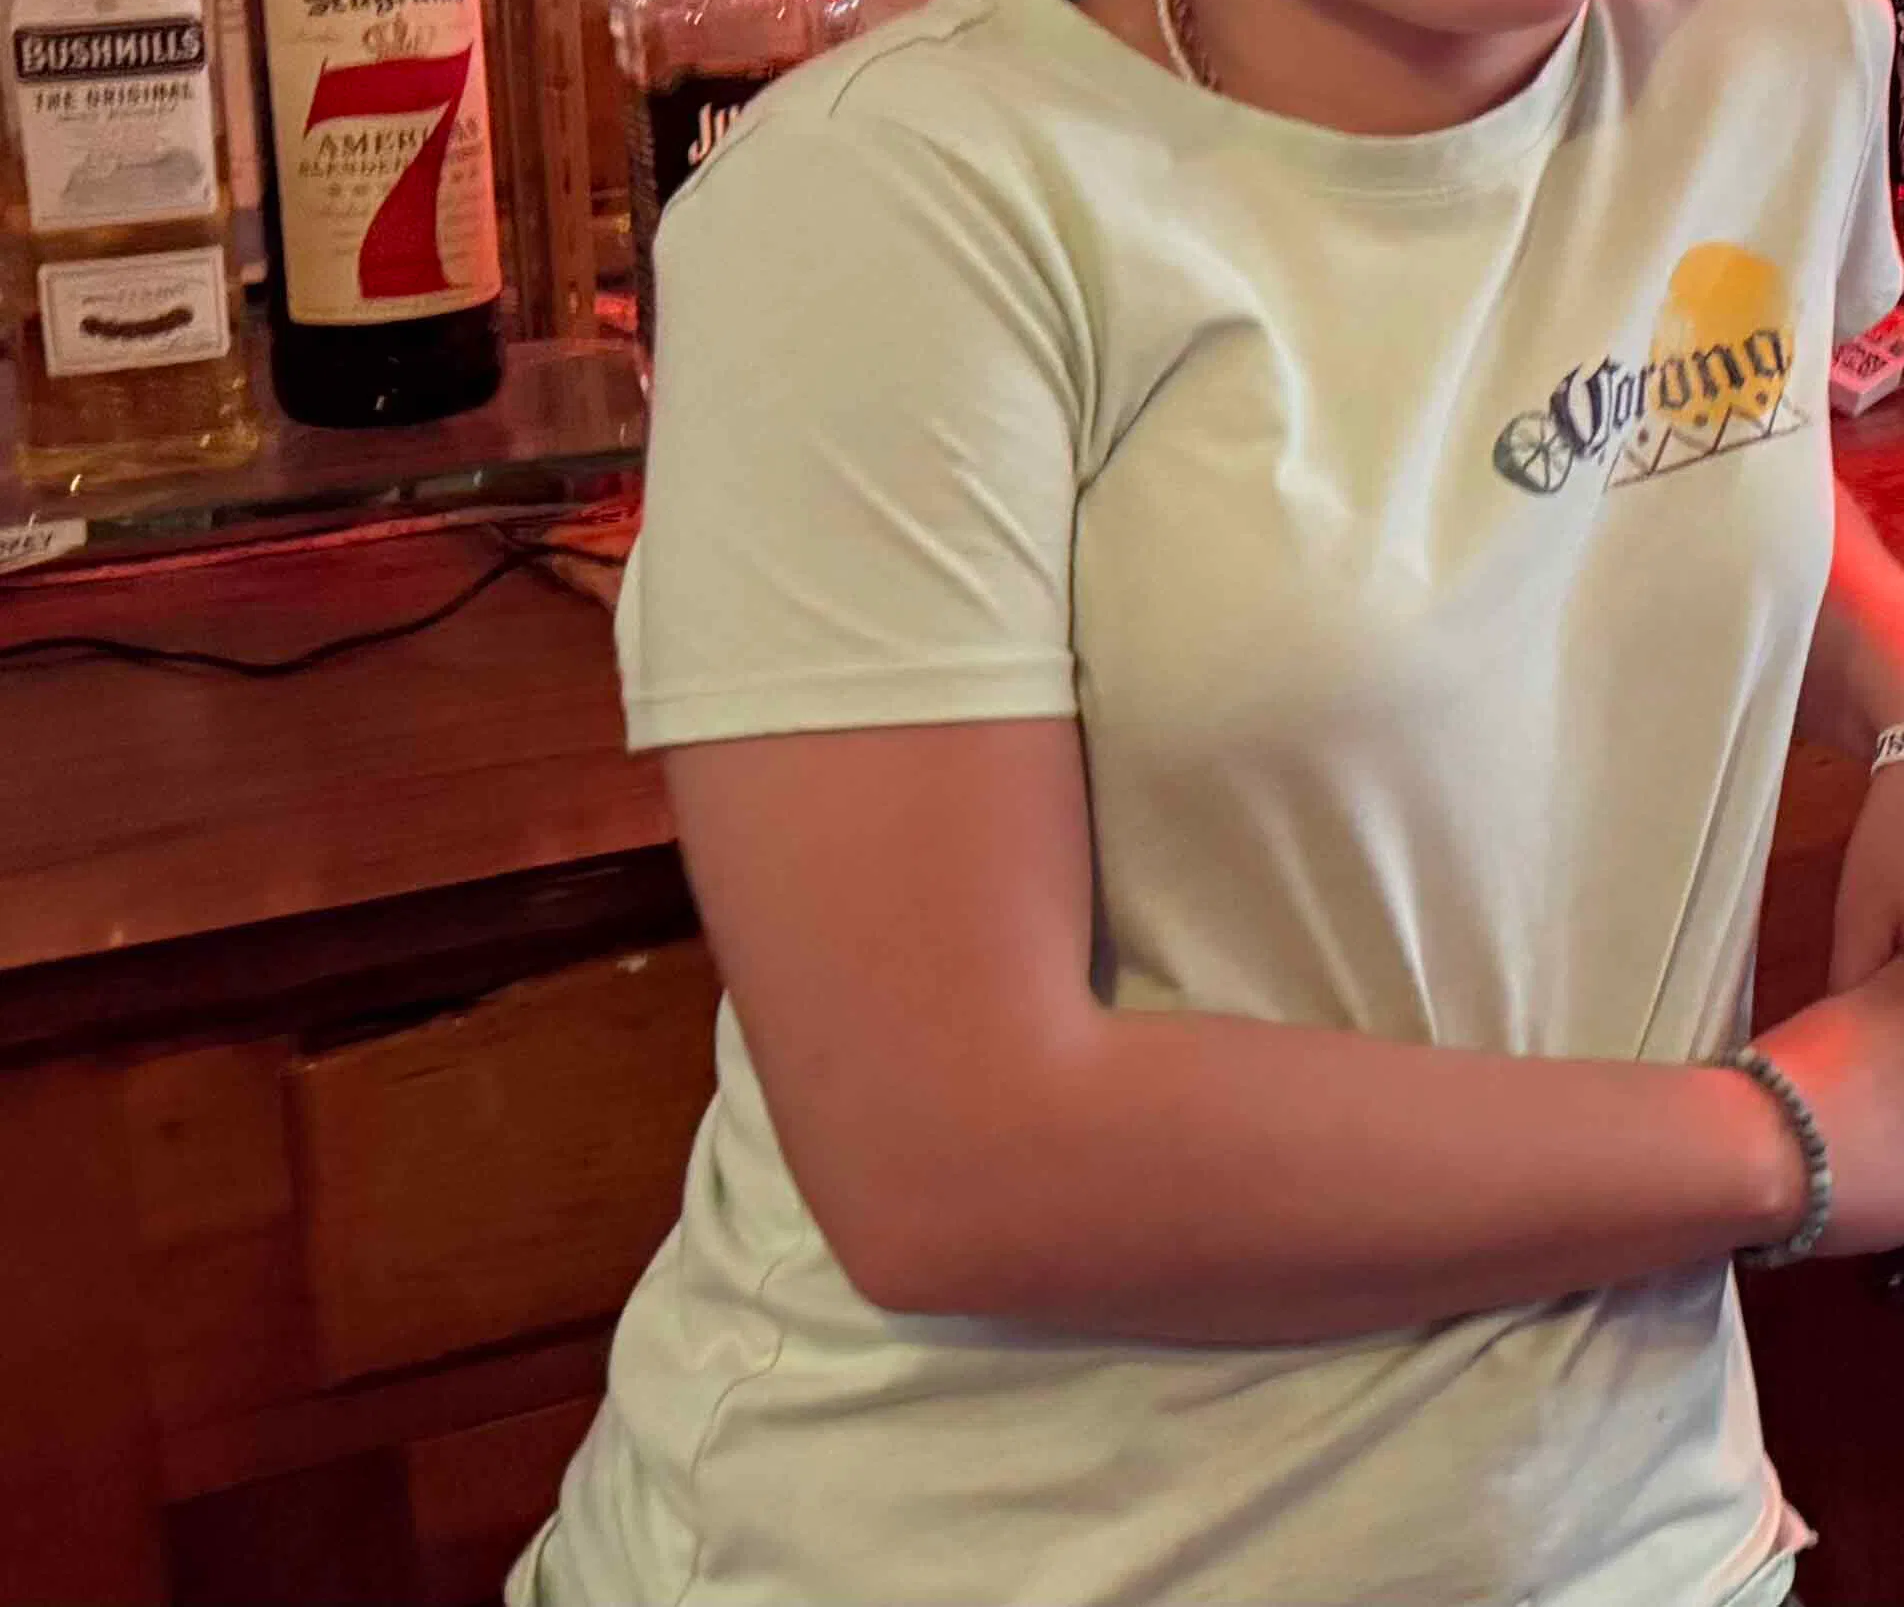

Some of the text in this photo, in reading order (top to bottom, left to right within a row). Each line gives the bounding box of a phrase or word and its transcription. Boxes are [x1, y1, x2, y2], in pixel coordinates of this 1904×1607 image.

[21, 26, 201, 73] BUSHMILLS
[303, 40, 474, 300] 7
[1548, 326, 1791, 461] Corona
